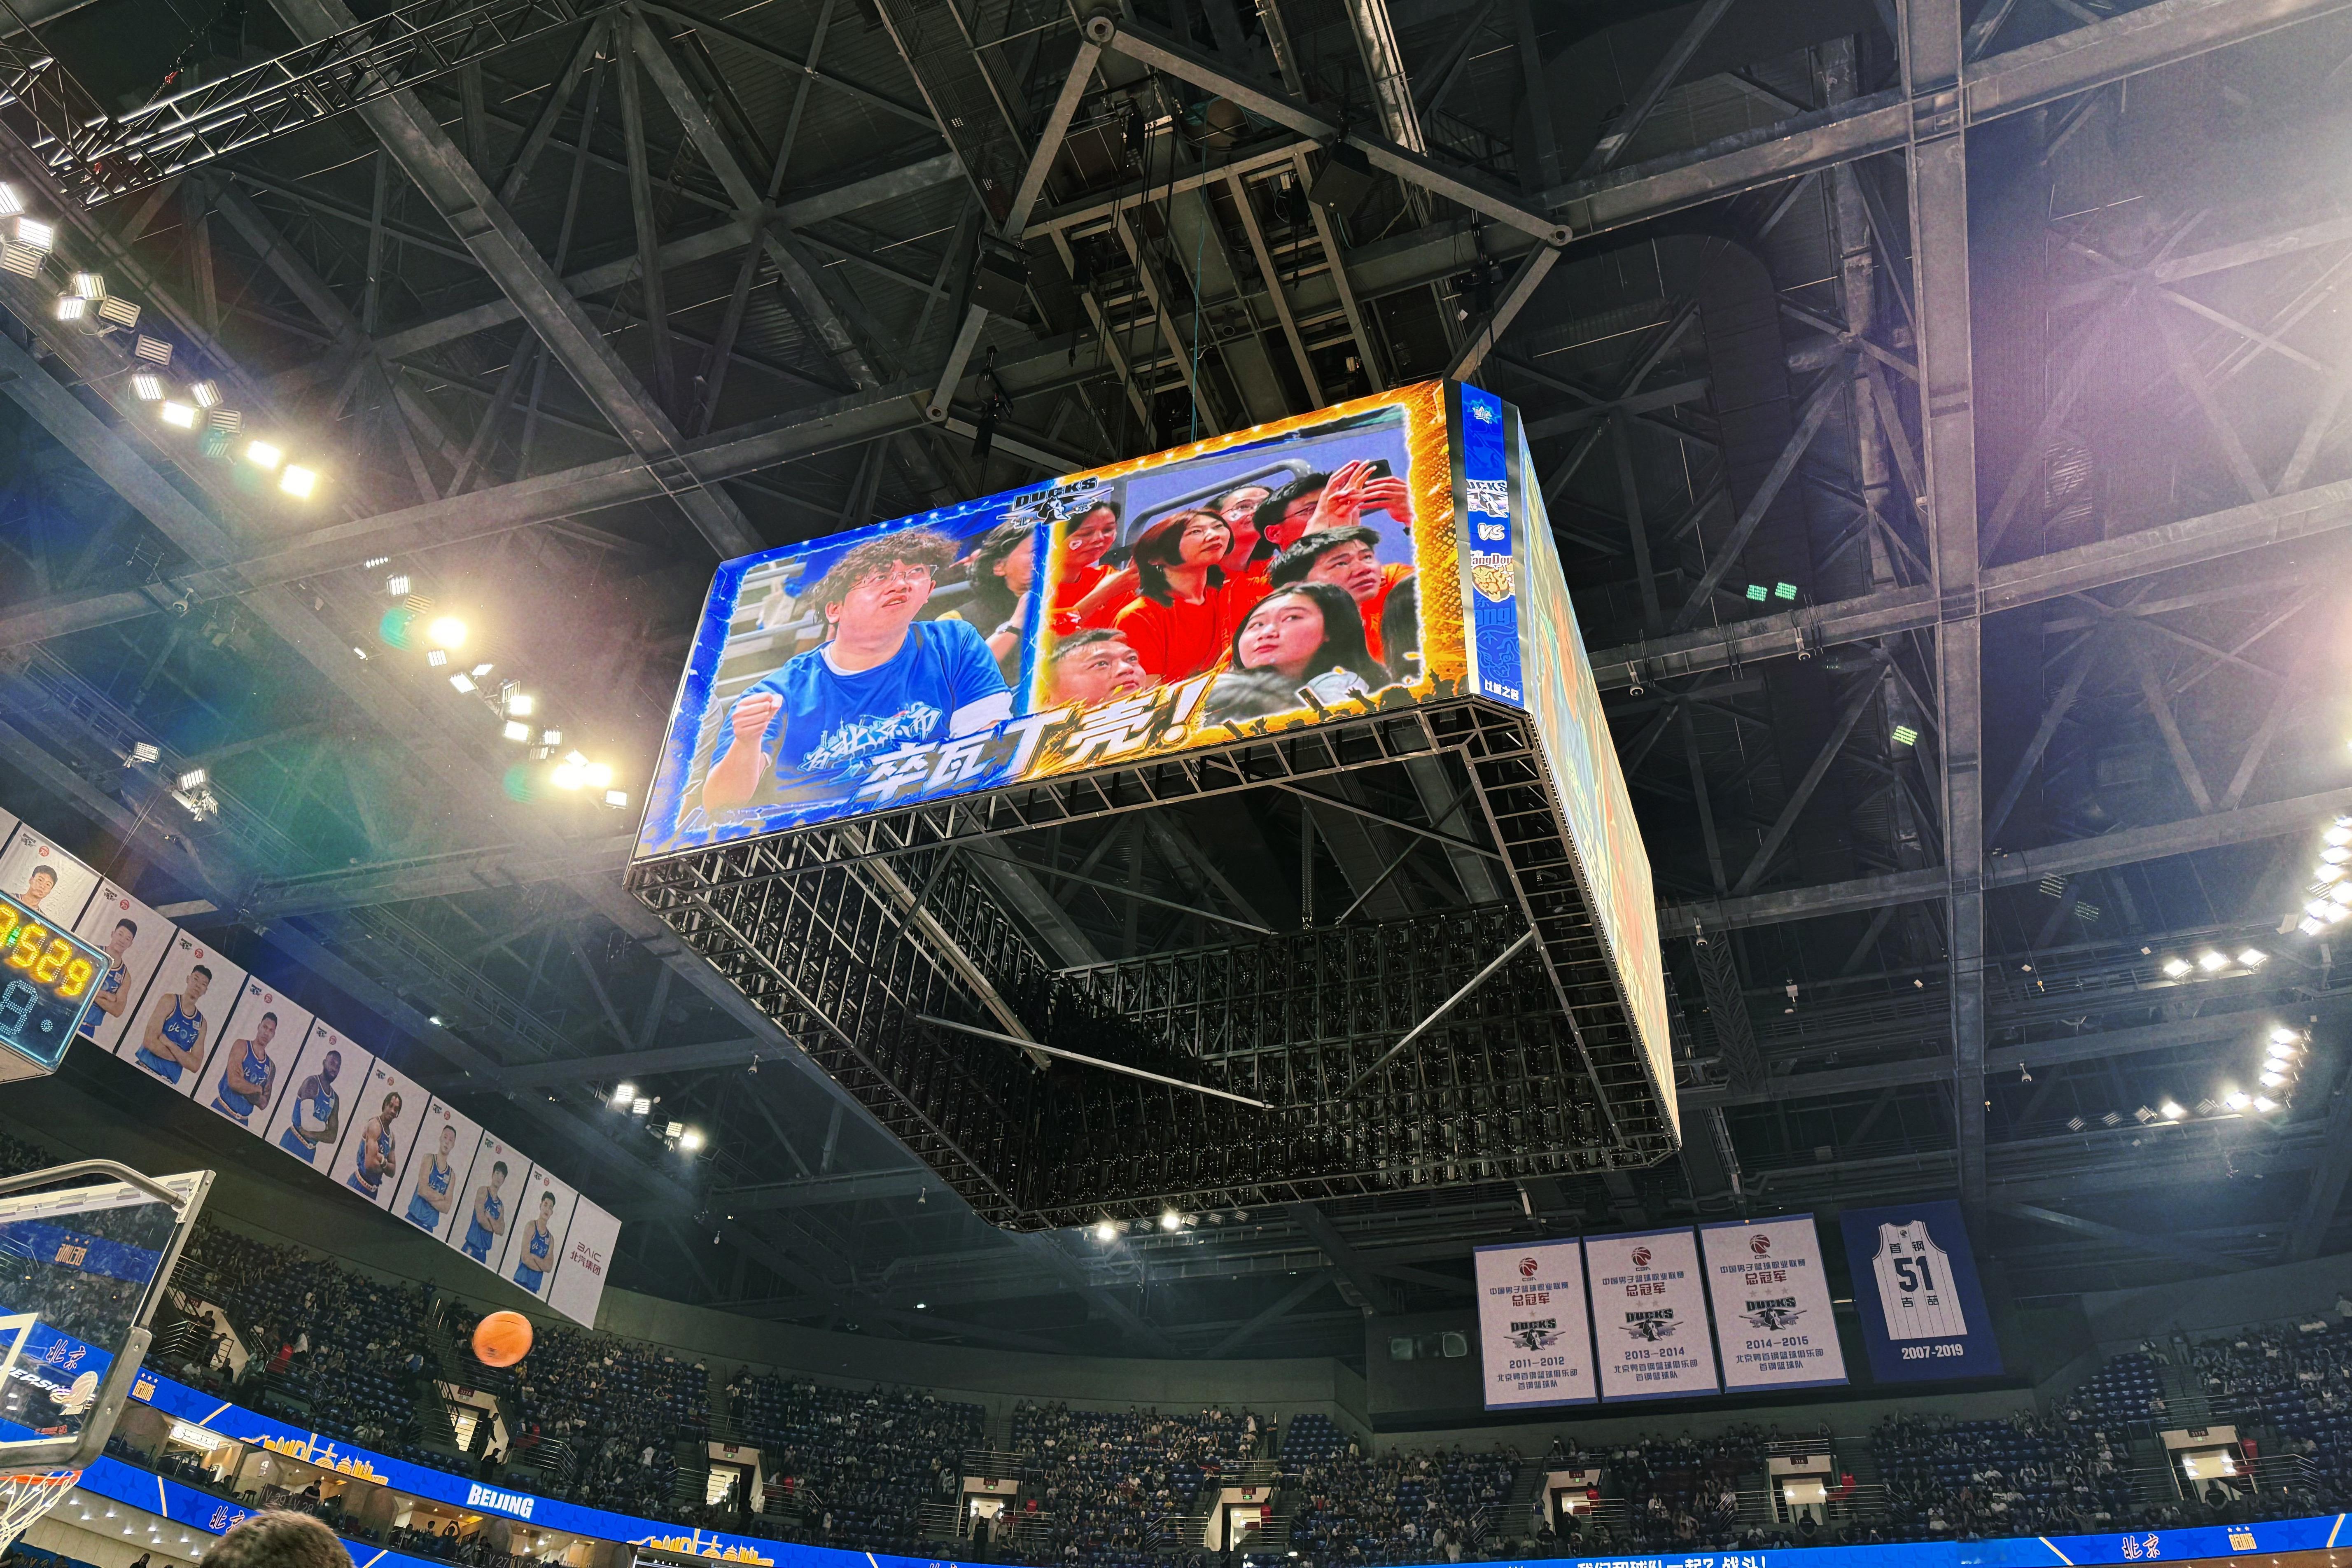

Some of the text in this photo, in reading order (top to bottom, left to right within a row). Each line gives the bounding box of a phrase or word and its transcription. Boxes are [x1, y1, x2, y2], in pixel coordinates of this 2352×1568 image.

[1013, 476, 1099, 511] DUCKS
[1478, 523, 1505, 540] VS
[577, 1242, 601, 1262] BAIC
[1889, 1241, 1925, 1253] 首钢
[570, 1251, 601, 1276] 北汽集团
[1720, 1259, 1806, 1273] 中国男子篮球职业联赛
[1602, 1271, 1684, 1285] 中国男子篮球职业联赛
[1745, 1270, 1787, 1285] 总冠军
[1894, 1255, 1934, 1292] 51
[1490, 1282, 1568, 1295] 中国男子篮球职业联赛
[1626, 1282, 1666, 1296] 总冠军
[1512, 1292, 1550, 1307] 总冠军
[1745, 1296, 1796, 1312] DUCKS
[1626, 1308, 1673, 1323] DUCKS
[1510, 1318, 1556, 1333] DUCKS
[46, 1339, 86, 1370] 北京
[1901, 1344, 1964, 1360] 2007-2019
[467, 1484, 534, 1519] BEIJING
[209, 1506, 245, 1533] 北京
[2121, 1533, 2160, 1560] 北京
